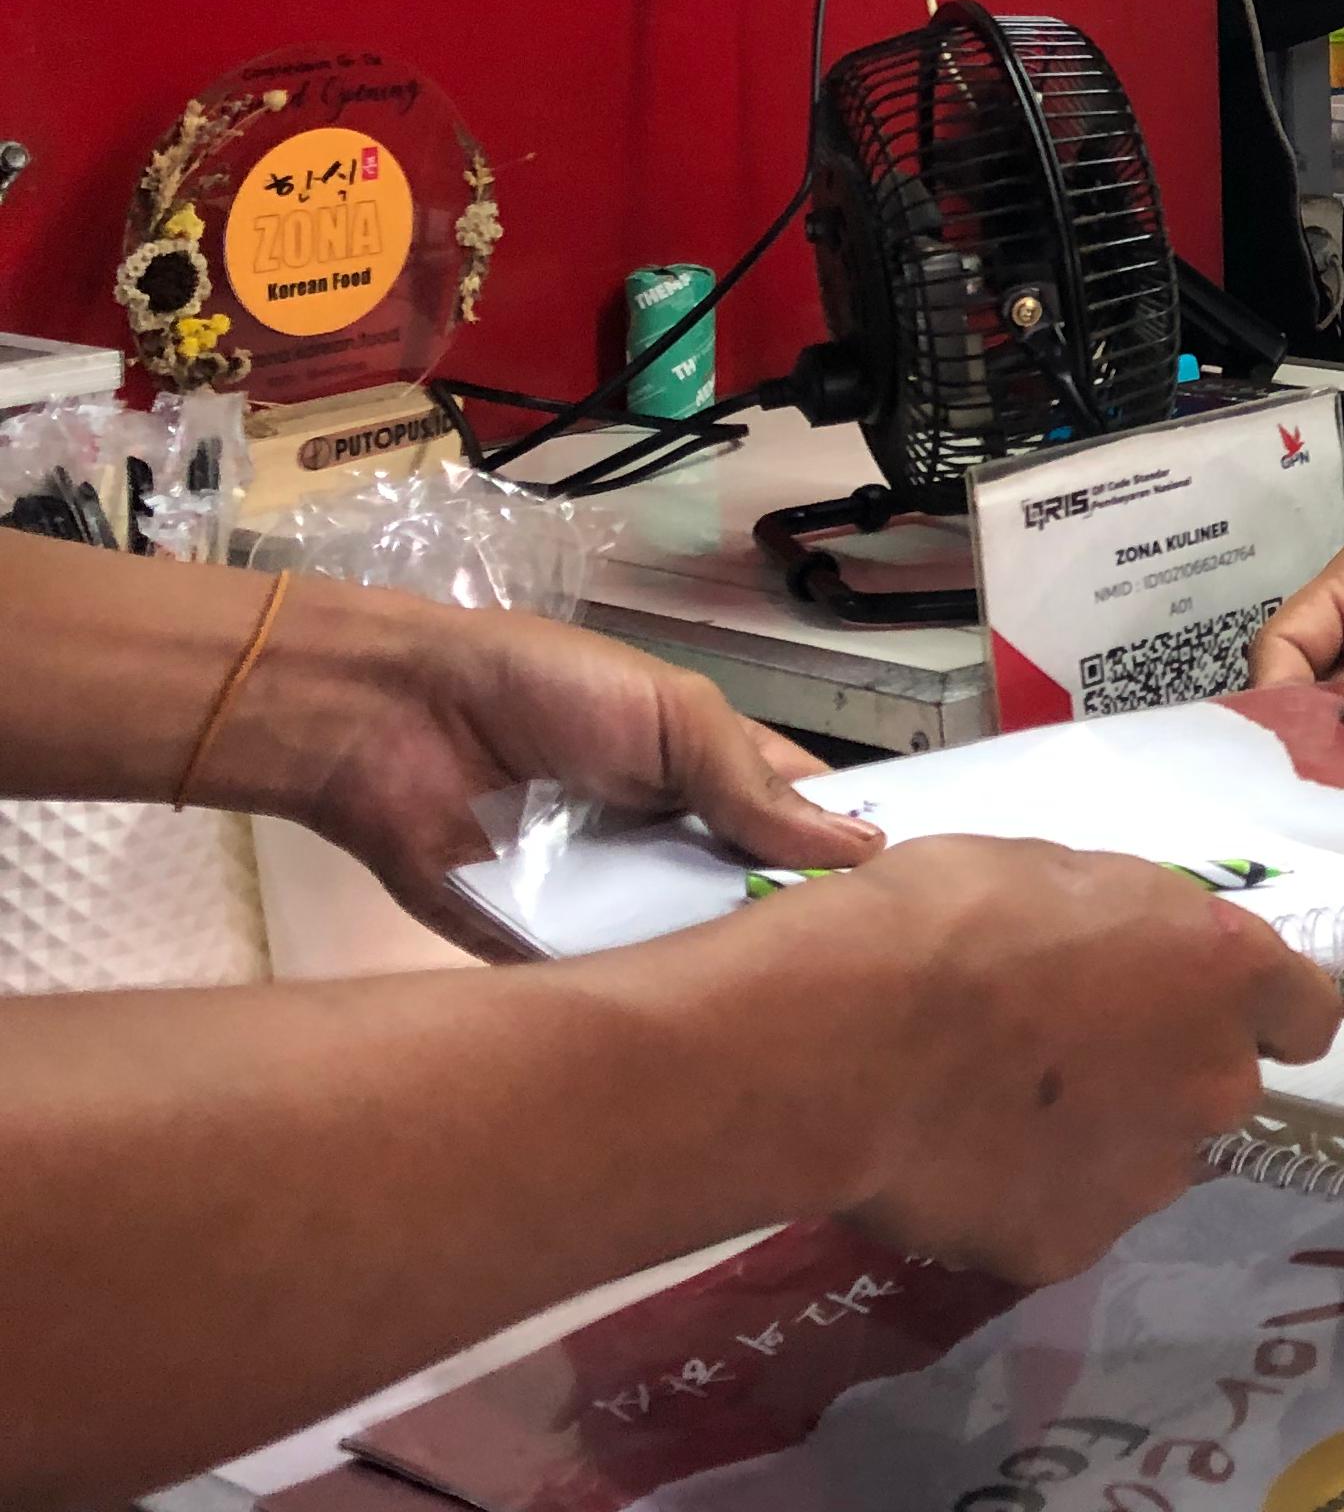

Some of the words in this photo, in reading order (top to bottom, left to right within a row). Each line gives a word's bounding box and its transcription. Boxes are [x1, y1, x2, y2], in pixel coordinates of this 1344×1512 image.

[252, 199, 384, 275] ZONA
[267, 276, 329, 302] Korean
[332, 266, 373, 291] Food
[1021, 488, 1092, 532] QRIS
[1114, 539, 1164, 567] ZONA
[1165, 520, 1230, 553] KULINER
[1093, 580, 1135, 604] NMID
